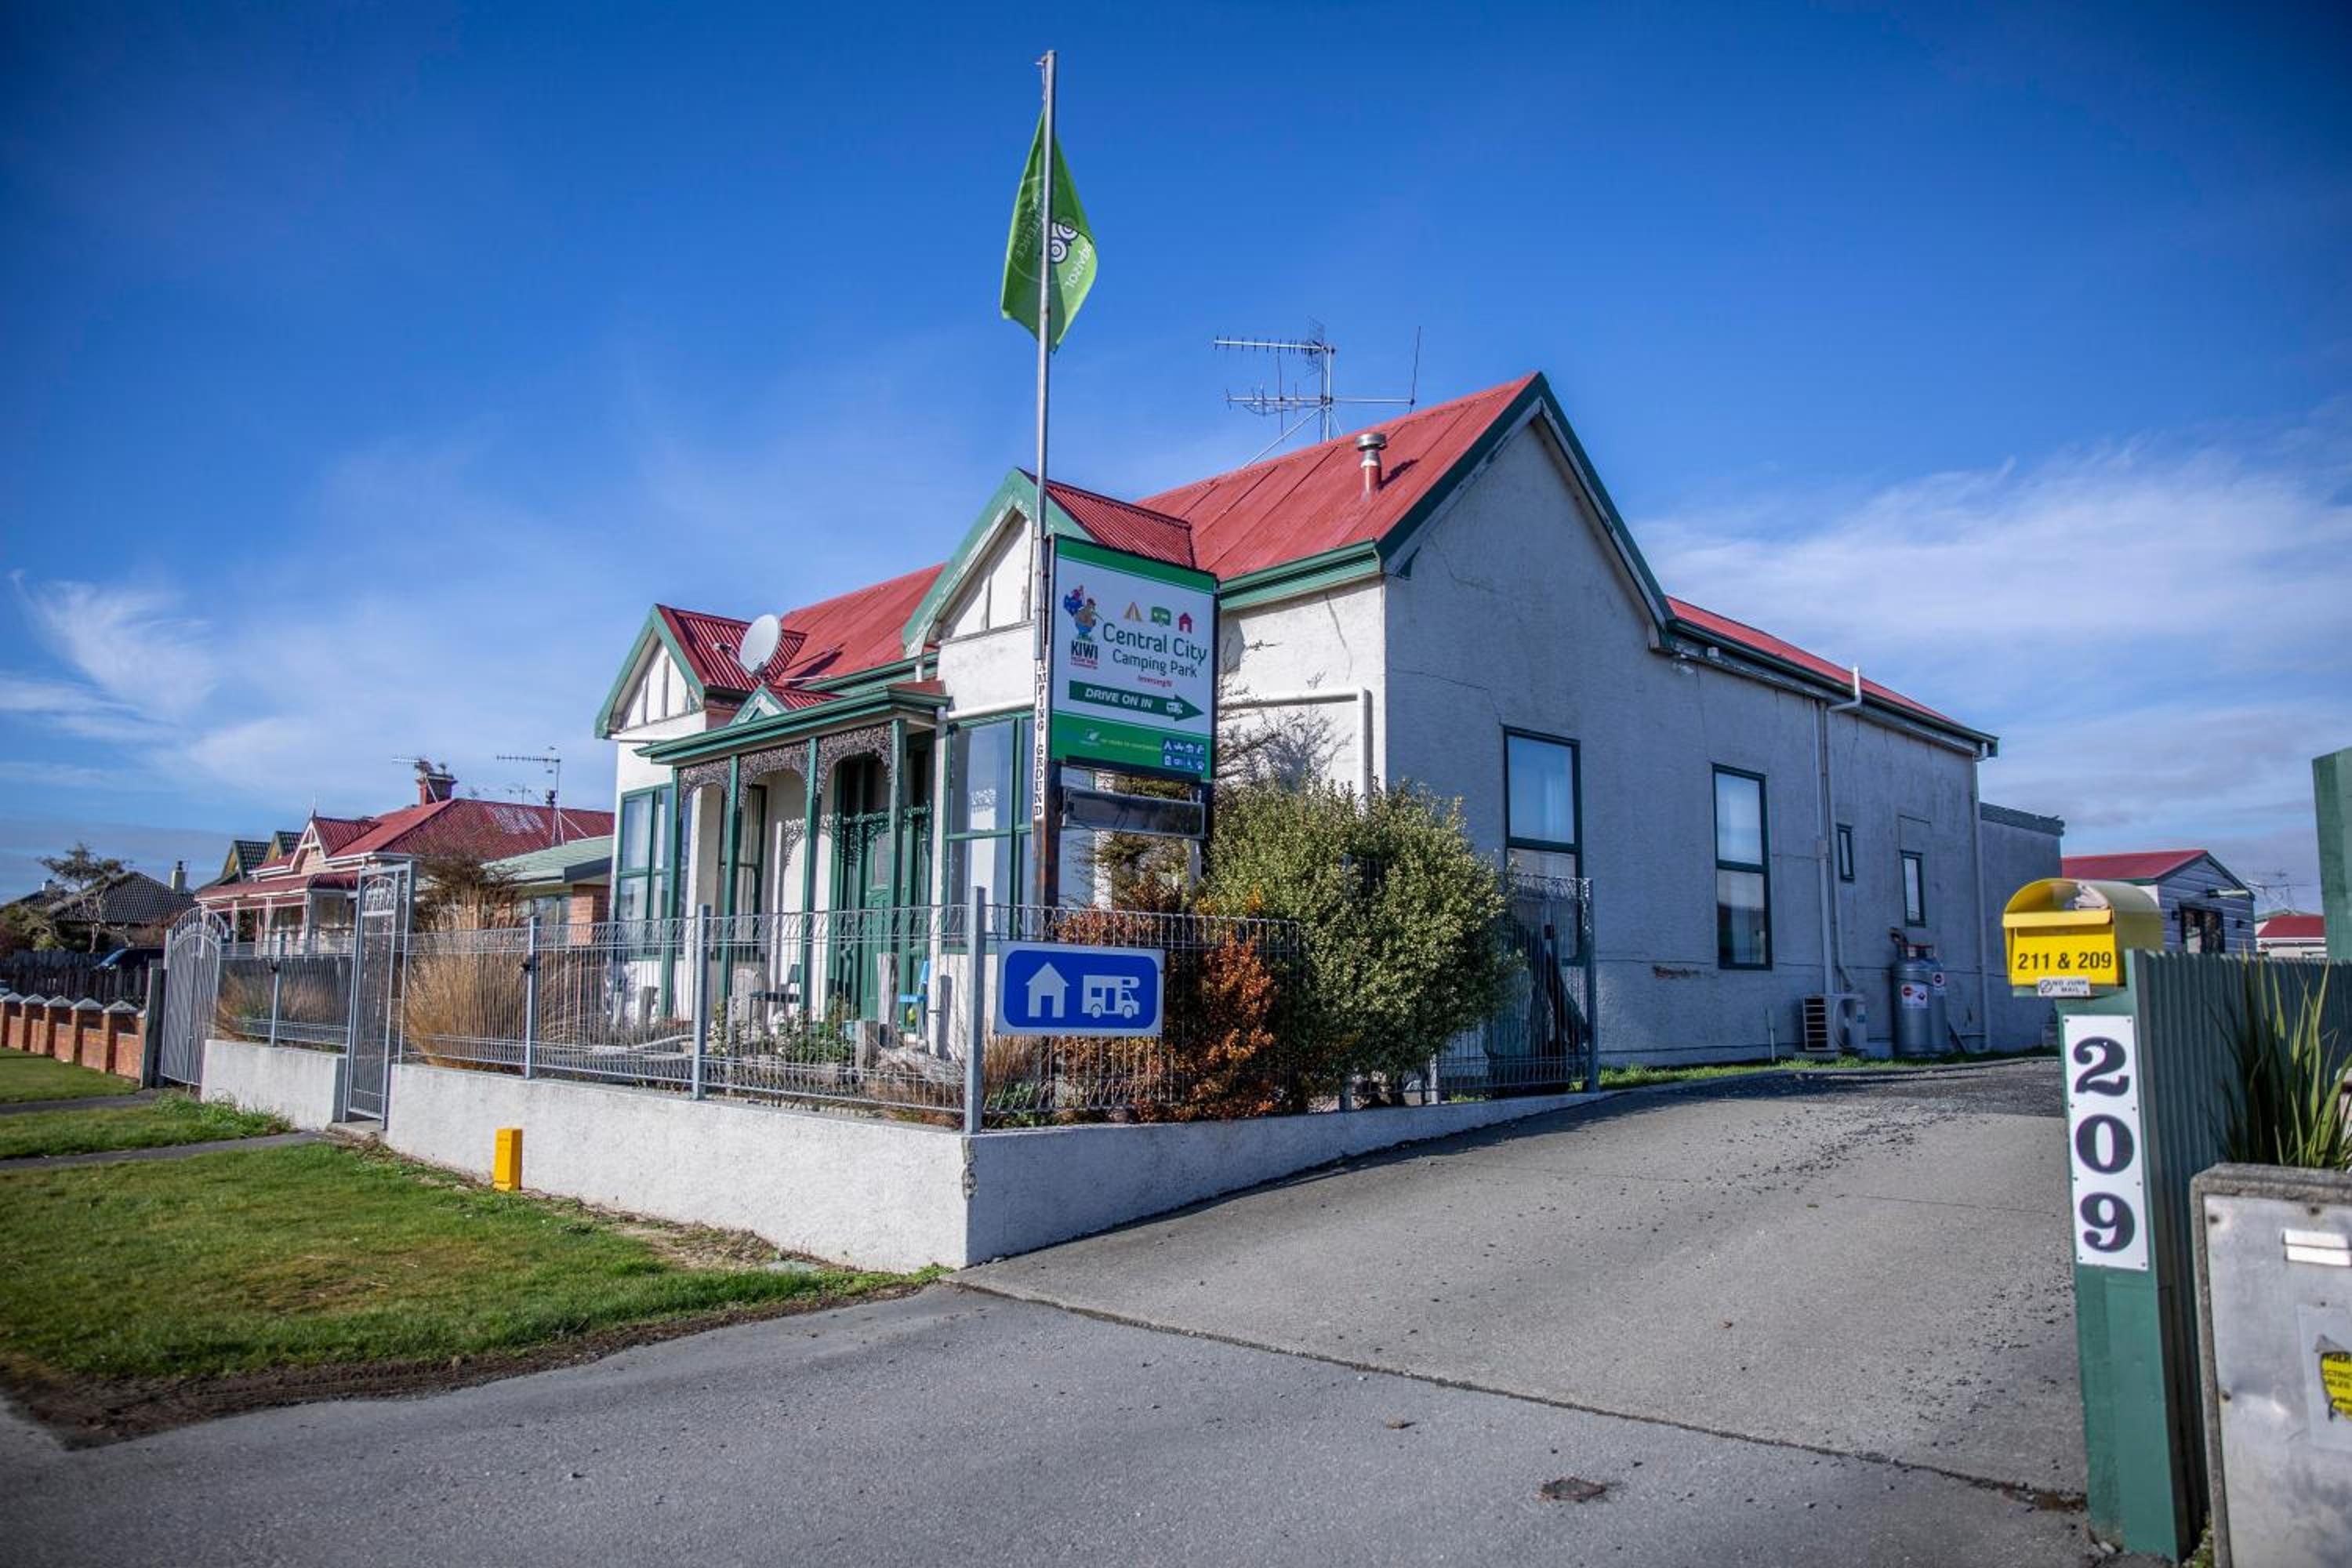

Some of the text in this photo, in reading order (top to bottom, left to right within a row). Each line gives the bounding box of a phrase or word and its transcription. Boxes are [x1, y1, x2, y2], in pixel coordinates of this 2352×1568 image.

[1071, 640, 1098, 660] KIWI
[1103, 622, 1207, 666] Central City
[1112, 648, 1198, 678] Camping Park
[1085, 688, 1153, 709] DRIVE ON IN
[1034, 662, 1047, 815] AMPING GROUND
[2018, 951, 2111, 969] 211 & 209
[2073, 1036, 2136, 1253] 209
